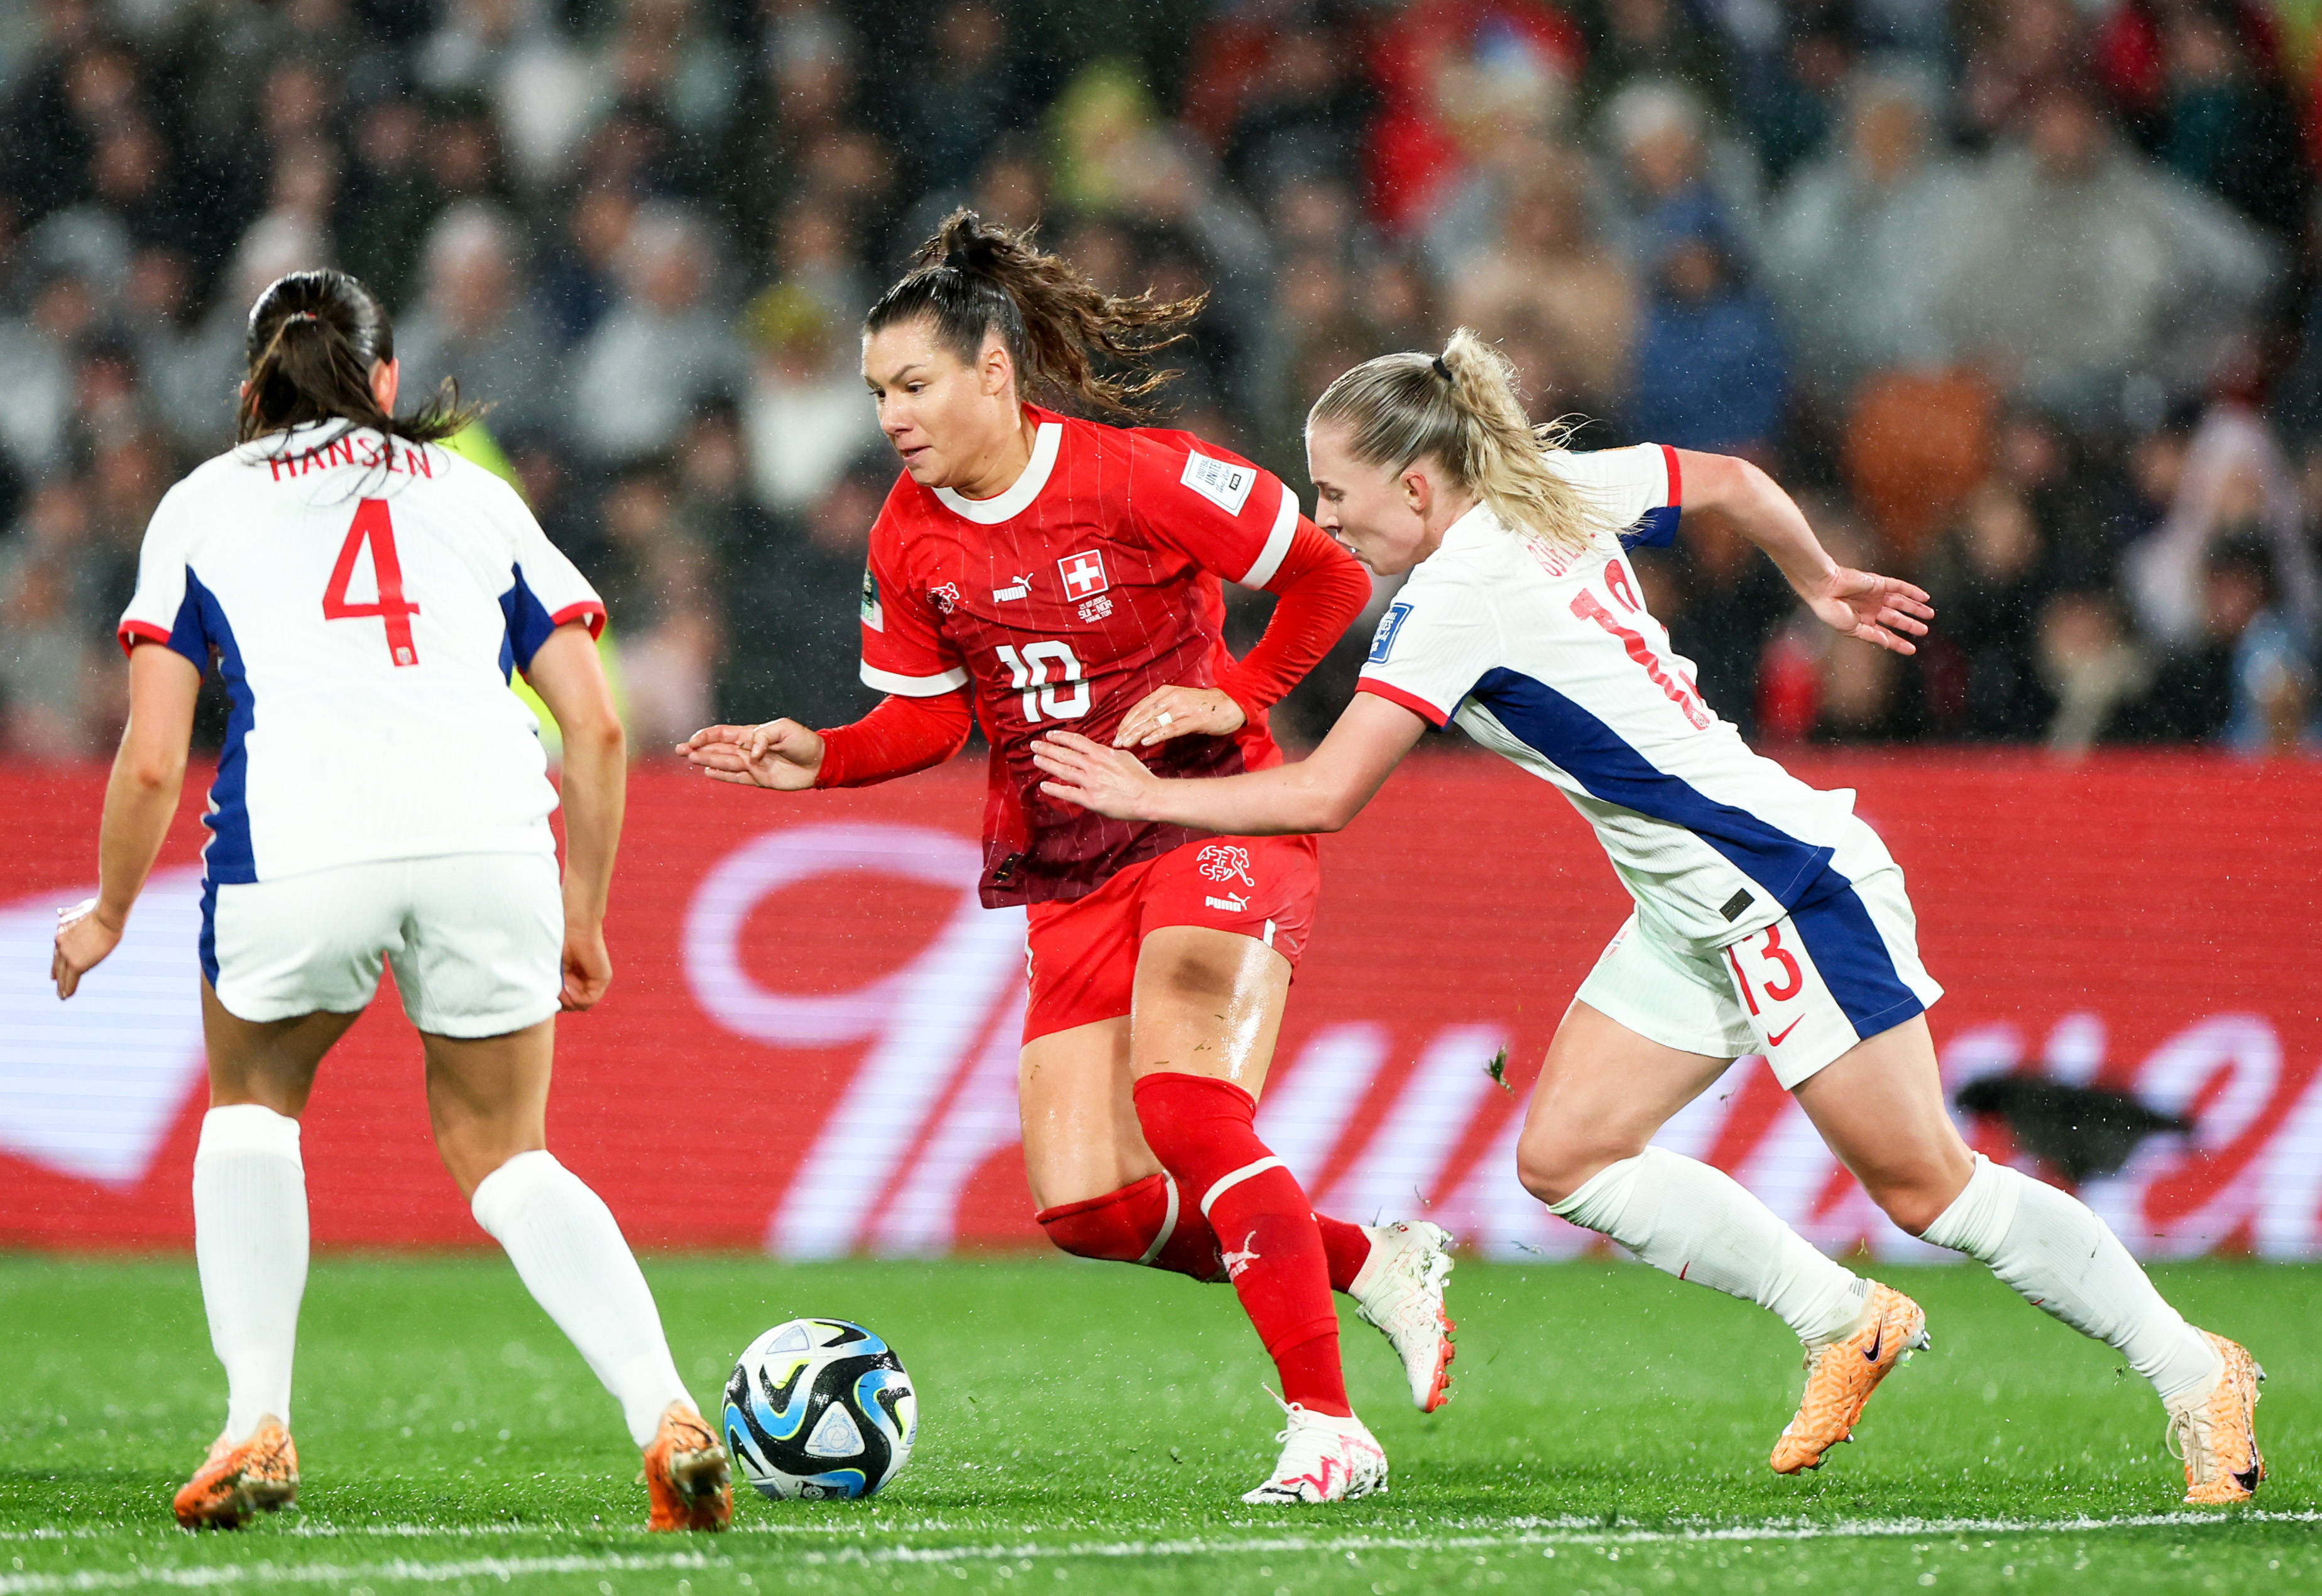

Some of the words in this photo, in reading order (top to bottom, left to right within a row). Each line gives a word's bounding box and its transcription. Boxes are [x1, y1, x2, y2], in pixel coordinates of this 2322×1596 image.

[268, 435, 432, 482] HANSEN
[322, 497, 420, 667] 4
[992, 585, 1027, 603] PUMA
[1085, 609, 1112, 624] HAMILTON
[995, 640, 1092, 723] 10
[1205, 895, 1242, 912] PUMA
[1725, 923, 1803, 1016] 13
